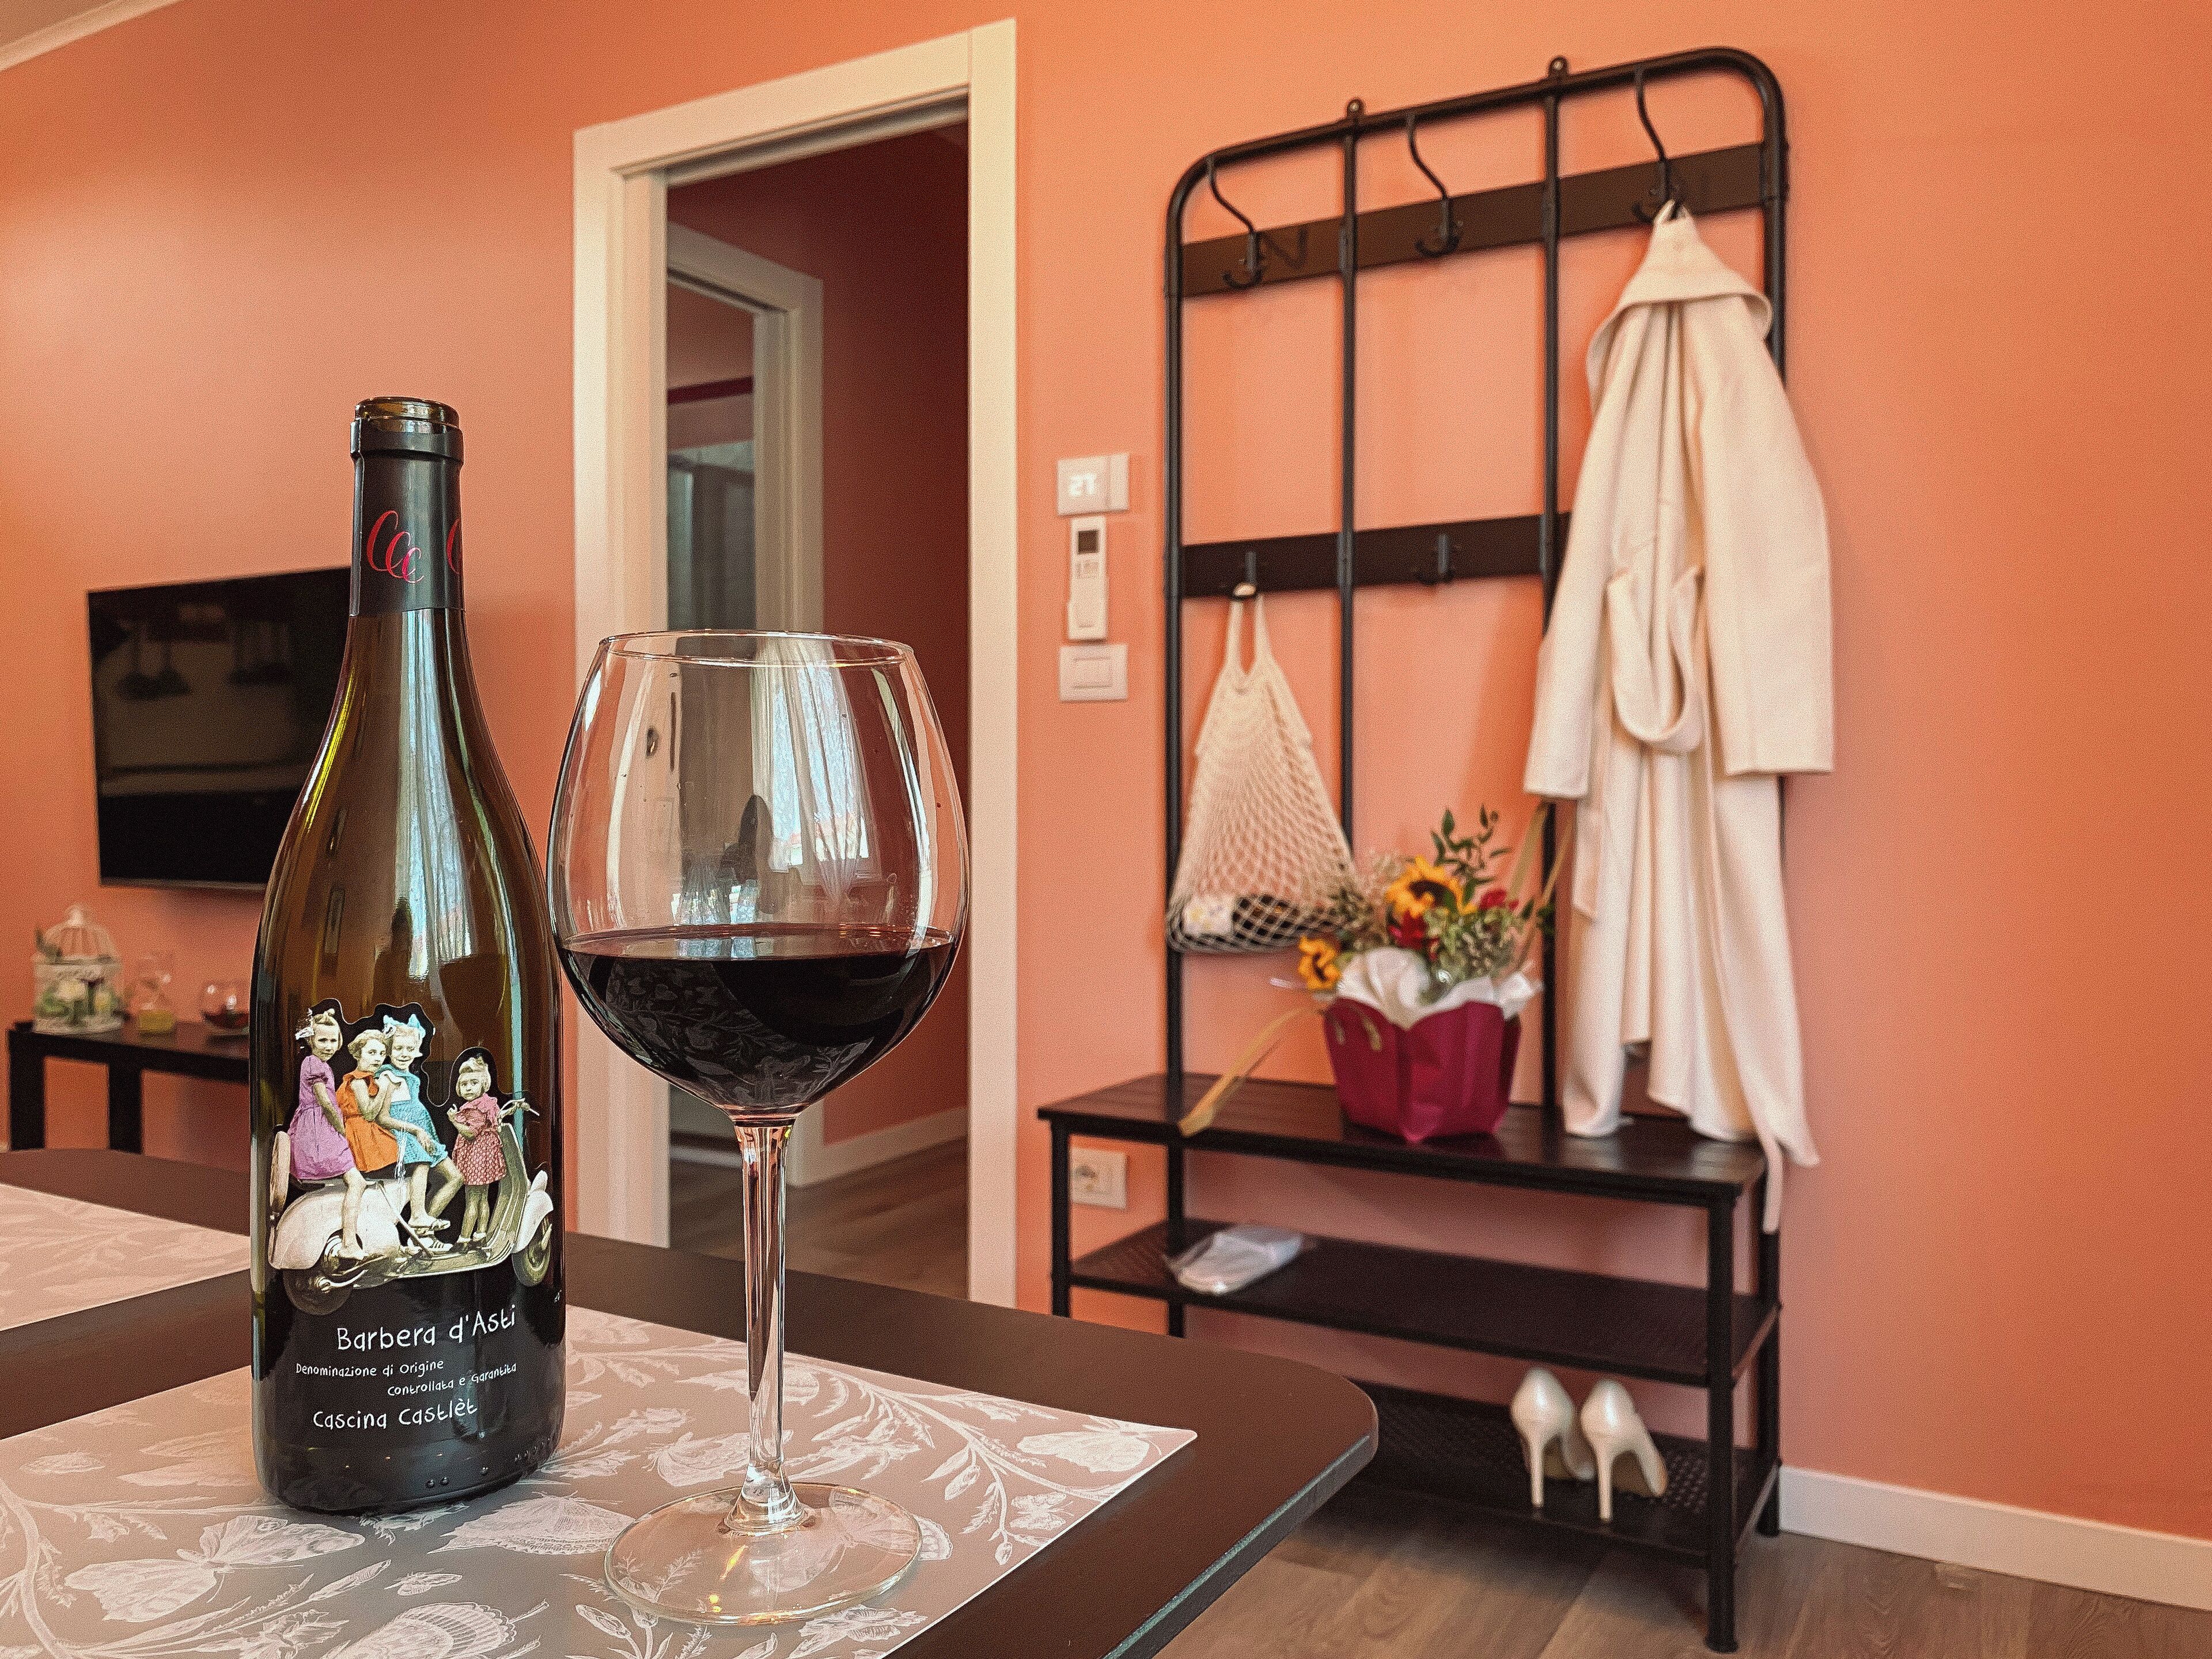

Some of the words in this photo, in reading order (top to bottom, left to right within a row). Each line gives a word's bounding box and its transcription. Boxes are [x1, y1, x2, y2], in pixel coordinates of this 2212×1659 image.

[337, 1326, 435, 1352] Barbera
[449, 1304, 516, 1343] d'Asti
[295, 1362, 377, 1377] Denominazione
[382, 1363, 394, 1377] di
[399, 1359, 444, 1378] Origine
[459, 1376, 466, 1387] e
[471, 1363, 517, 1384] Garantita
[313, 1410, 387, 1430] Cascina
[399, 1397, 478, 1426] Castlèt
